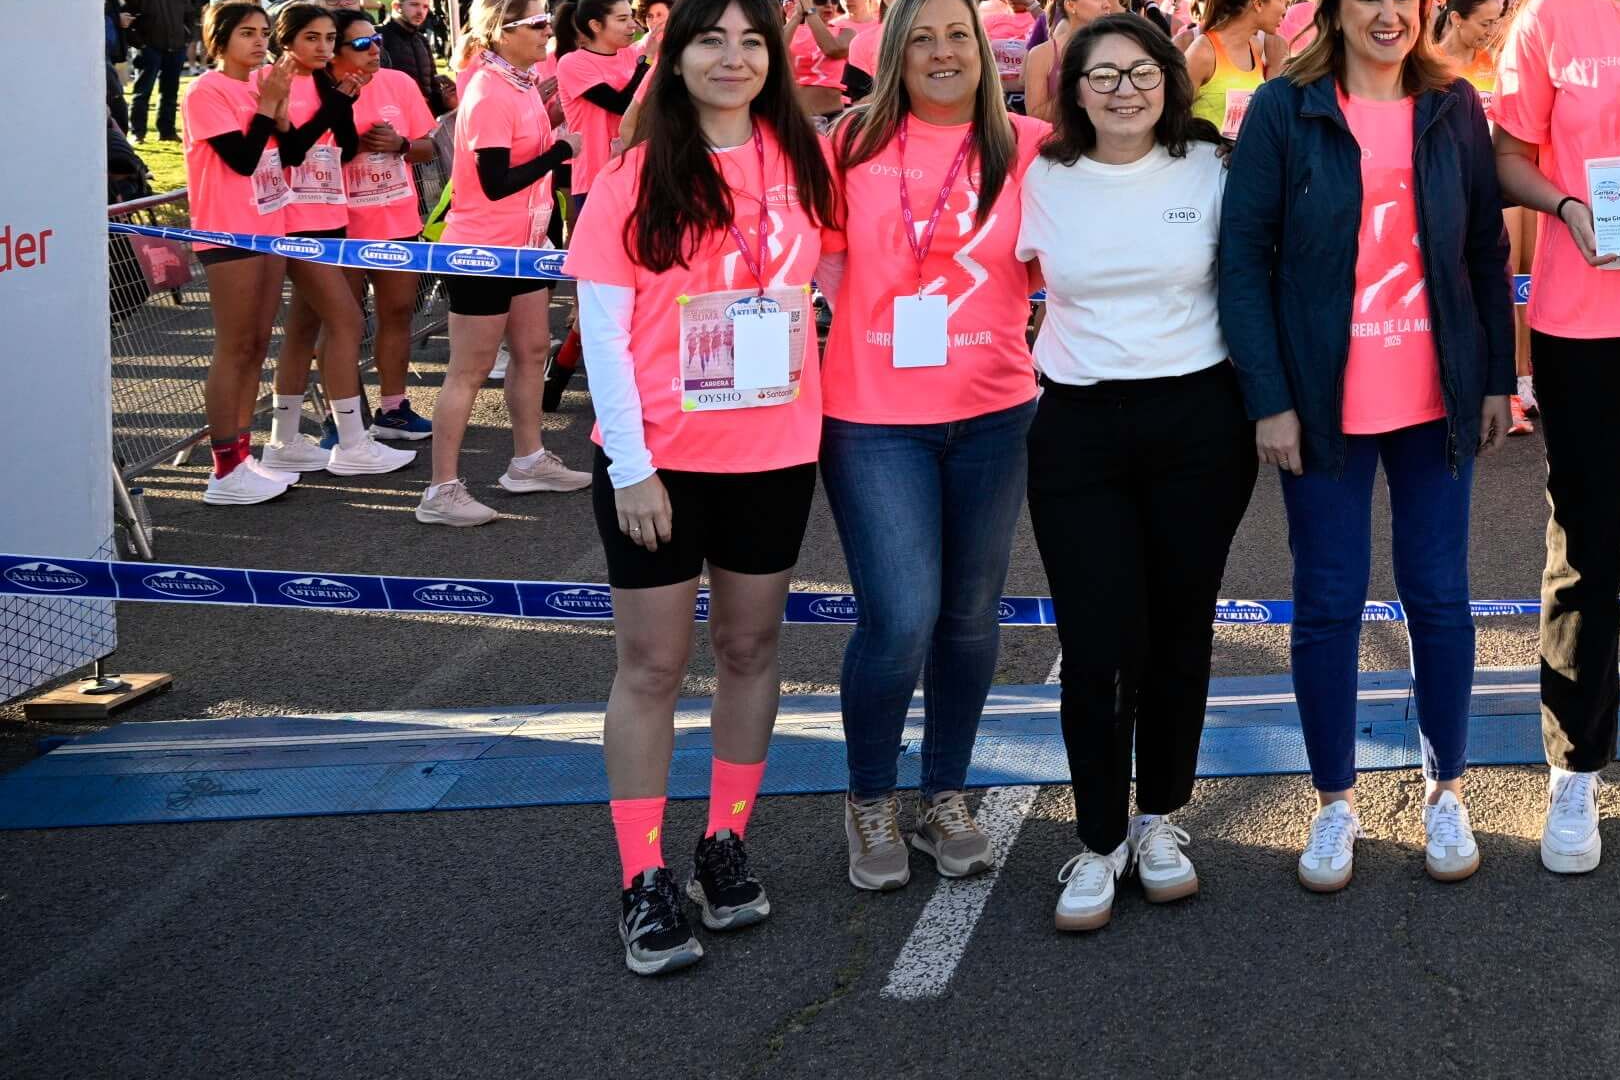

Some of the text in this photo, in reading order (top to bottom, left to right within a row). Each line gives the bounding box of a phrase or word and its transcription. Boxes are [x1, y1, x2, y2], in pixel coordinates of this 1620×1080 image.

[1168, 211, 1196, 221] ziaja
[954, 330, 993, 346] MUJER
[698, 392, 742, 404] OYSHO
[12, 570, 82, 585] ASTURIANA
[151, 576, 220, 592] ASTURIANA
[286, 584, 354, 600] ASTURIANA
[420, 590, 488, 604] ASTURIANA
